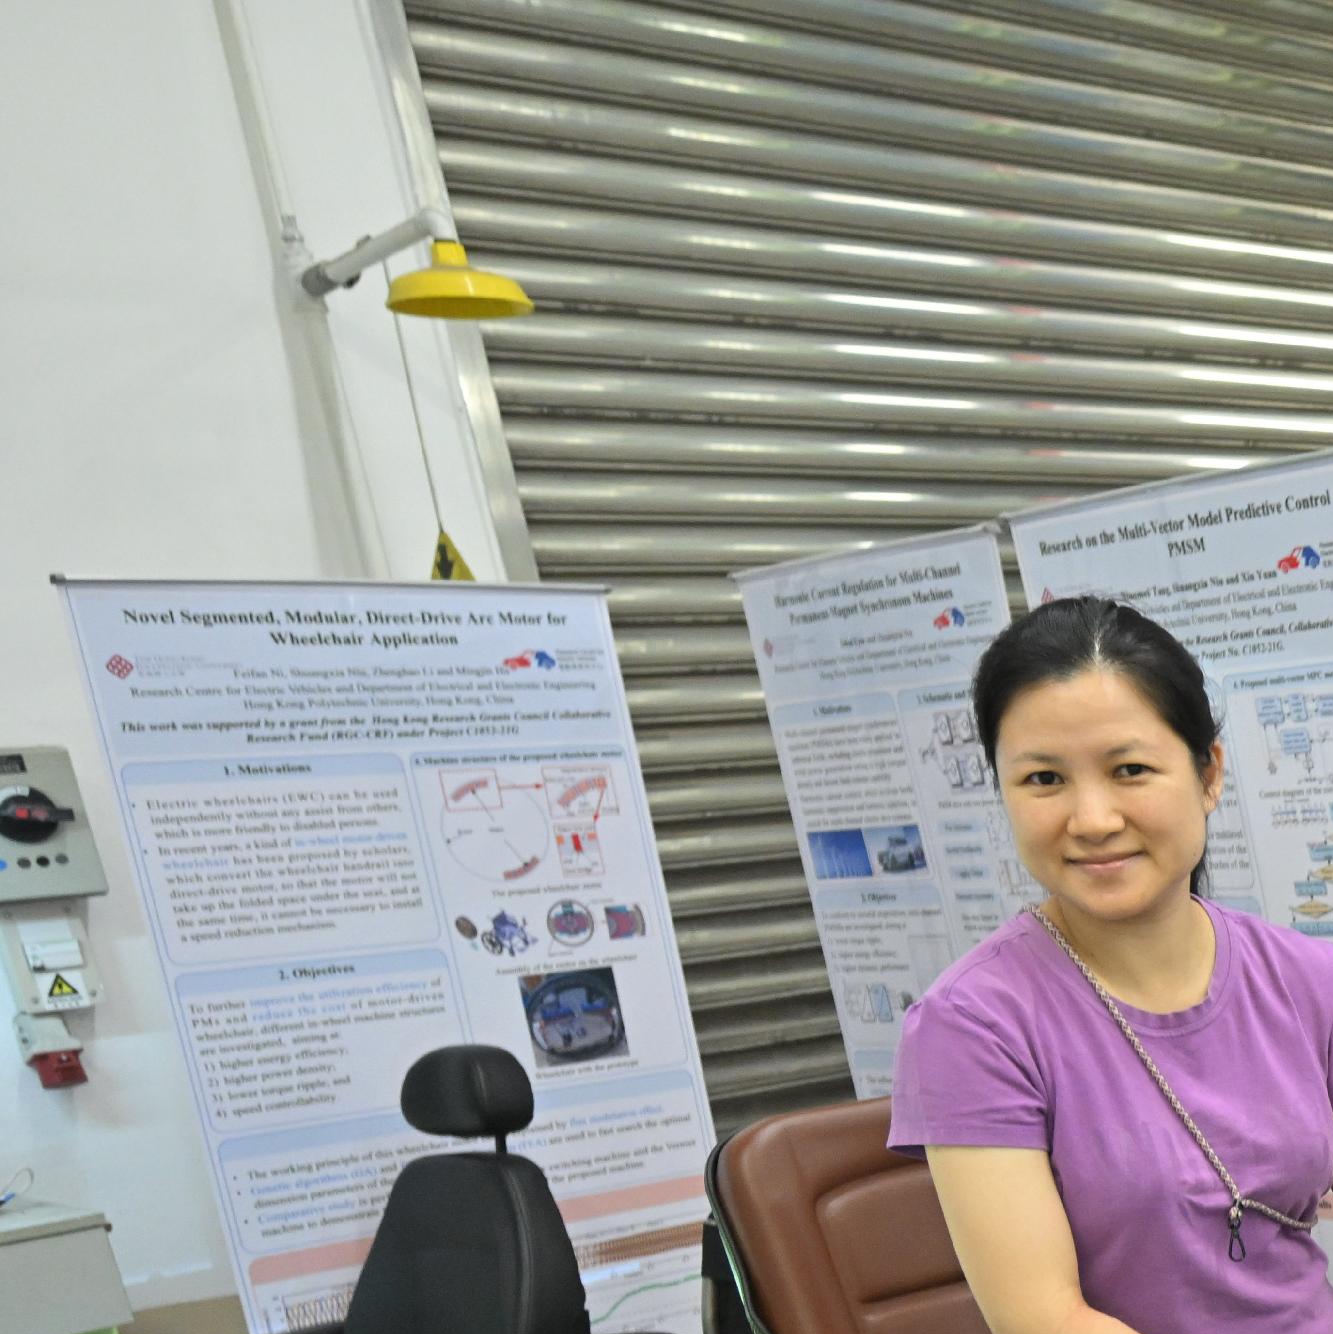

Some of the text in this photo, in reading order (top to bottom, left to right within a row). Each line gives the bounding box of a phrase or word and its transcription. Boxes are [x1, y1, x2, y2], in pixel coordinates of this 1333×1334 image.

[1039, 535, 1083, 556] Research
[1085, 535, 1098, 548] on
[1099, 530, 1115, 545] the
[1117, 519, 1185, 541] Multi-Vector
[1187, 509, 1223, 529] Model
[1225, 500, 1282, 523] Predictive
[1284, 490, 1331, 513] Control
[1167, 536, 1206, 558] PMSM
[123, 609, 566, 627] Novel Segmented, Modular, Direct-Drive Arc Motor for
[269, 631, 459, 649] Wheelchair Application
